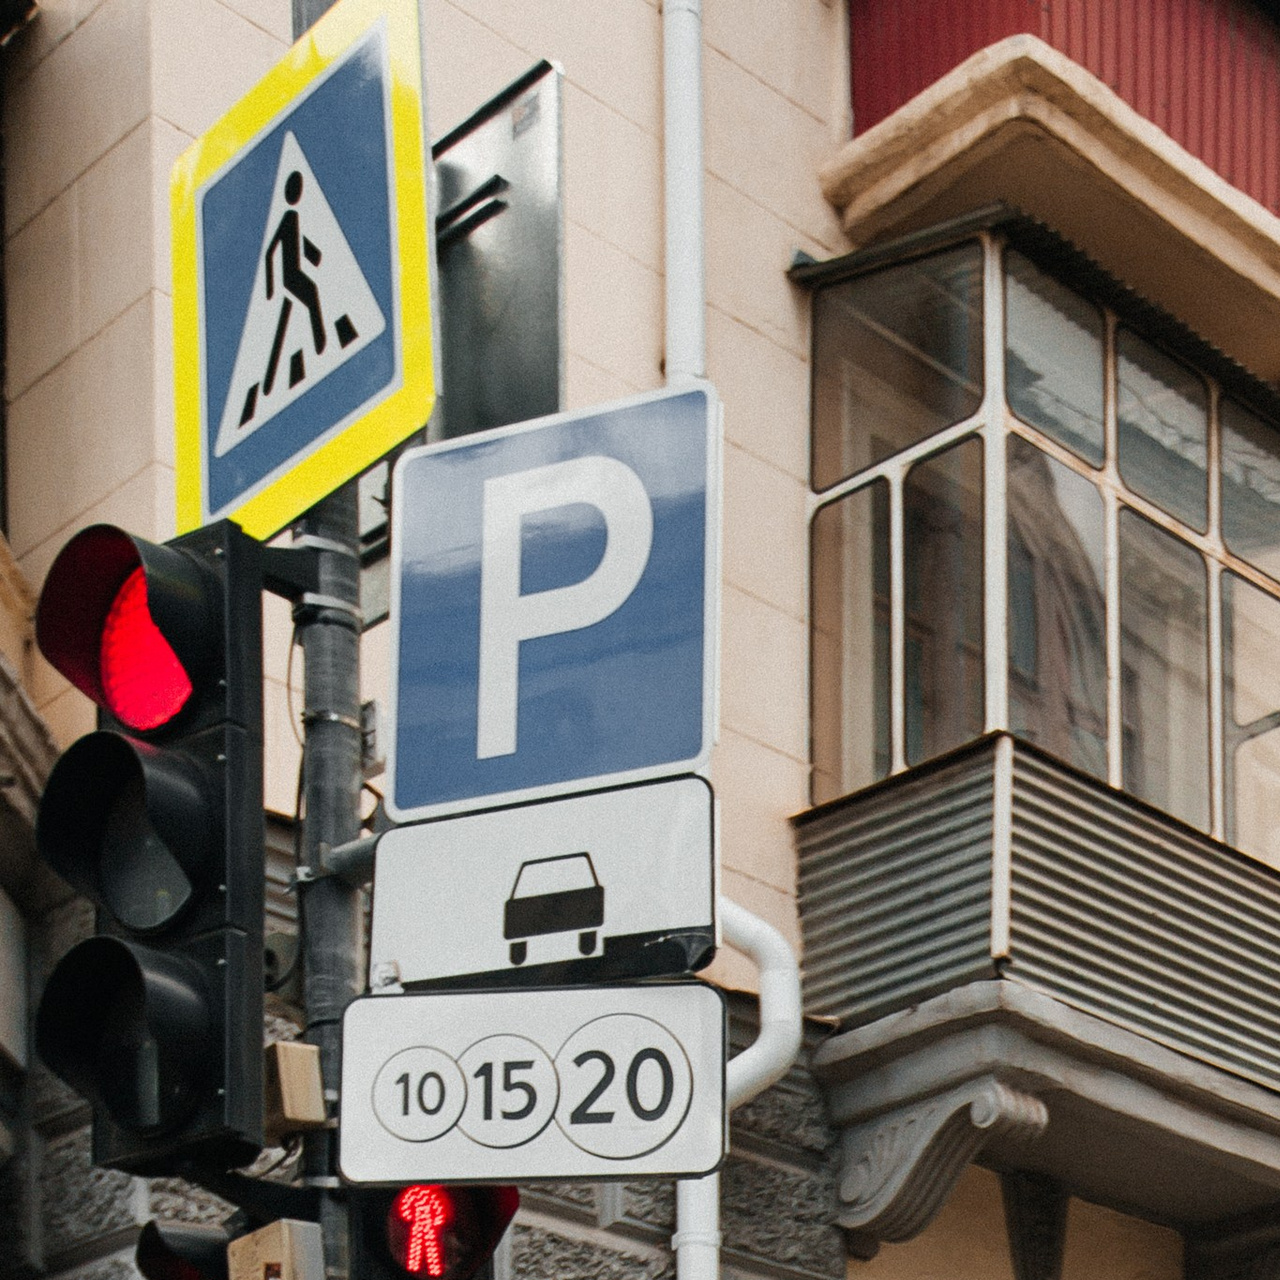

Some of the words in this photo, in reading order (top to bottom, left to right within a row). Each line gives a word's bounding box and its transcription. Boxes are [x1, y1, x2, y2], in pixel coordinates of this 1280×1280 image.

[476, 456, 654, 760] P
[394, 1071, 446, 1117] 10
[472, 1060, 538, 1122] 15
[568, 1047, 675, 1126] 20
